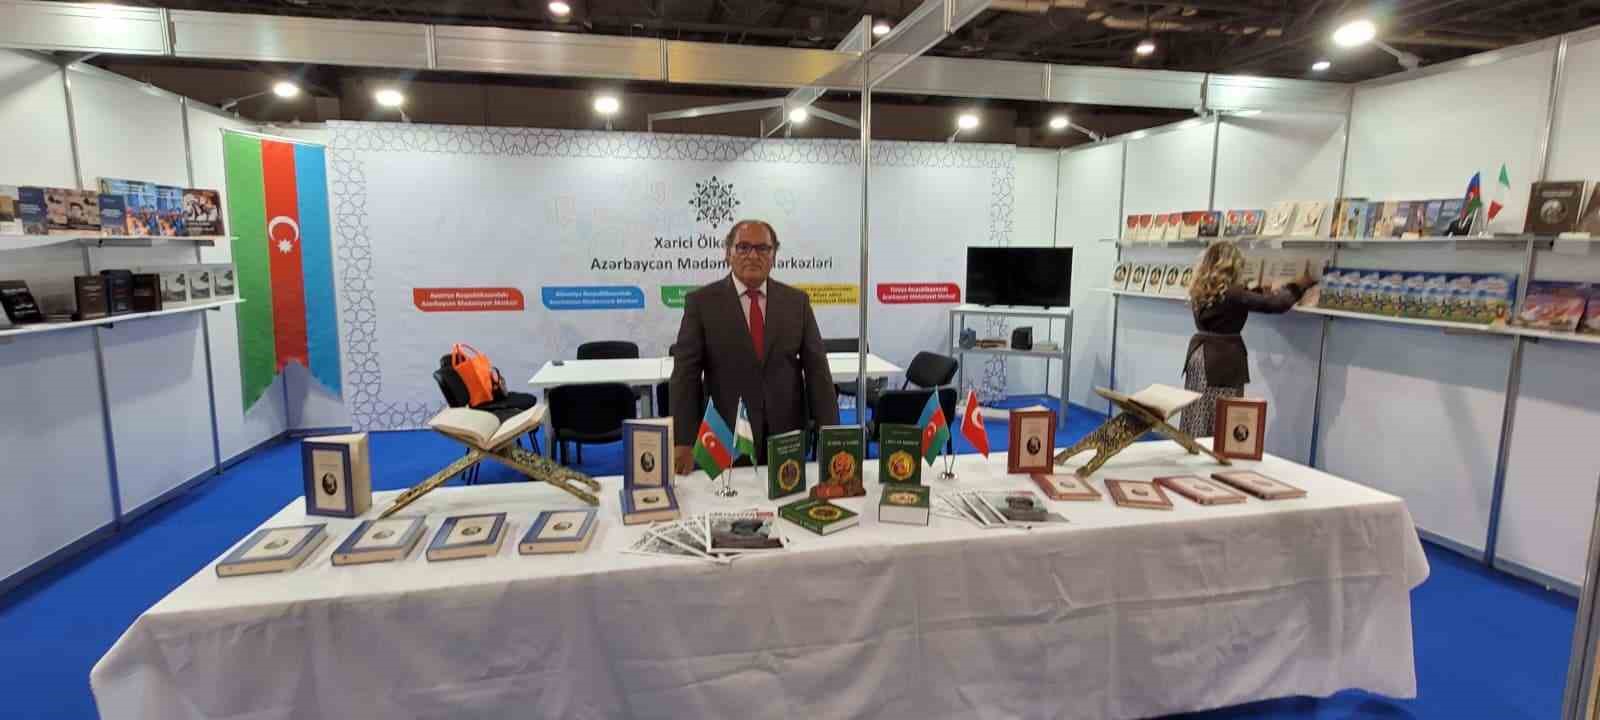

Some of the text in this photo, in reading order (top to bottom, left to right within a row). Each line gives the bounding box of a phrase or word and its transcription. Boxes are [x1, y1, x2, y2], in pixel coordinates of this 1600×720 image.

[655, 235, 693, 249] Xarici
[591, 256, 673, 272] Azərbaycan
[773, 255, 833, 269] ərkəzləri
